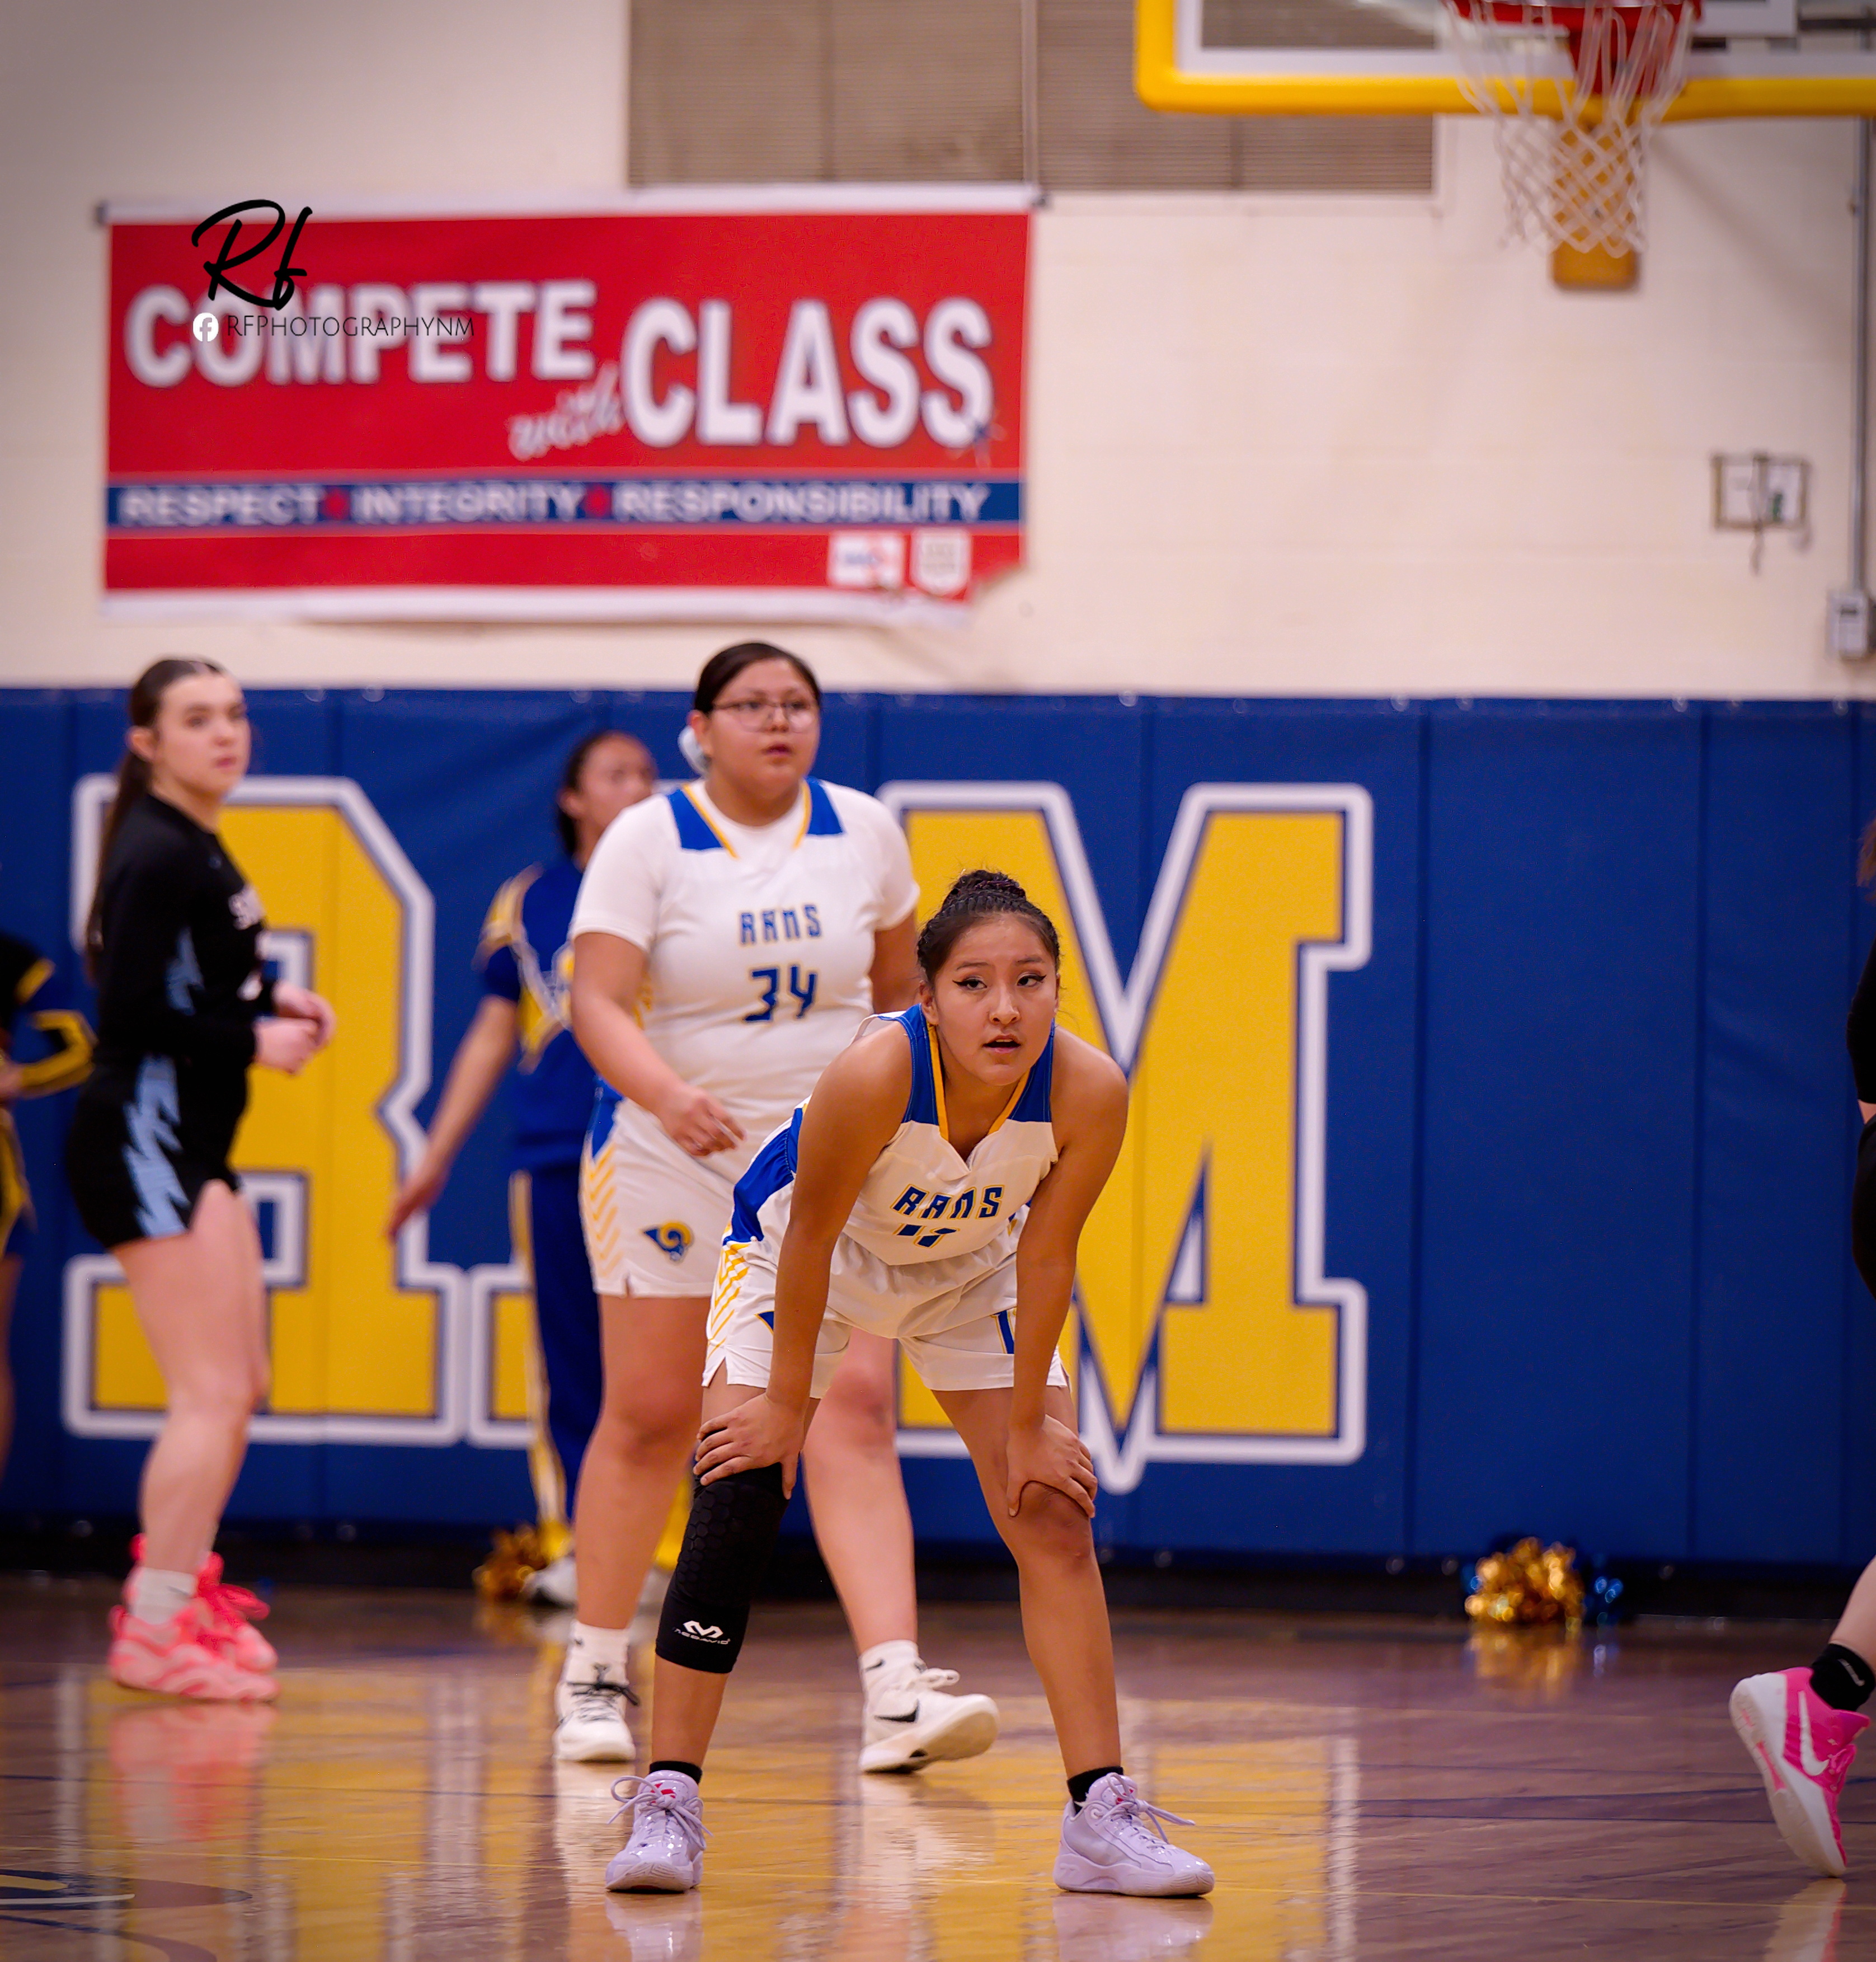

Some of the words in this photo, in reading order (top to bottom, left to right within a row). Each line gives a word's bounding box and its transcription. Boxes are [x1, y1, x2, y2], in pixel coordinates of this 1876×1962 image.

[124, 280, 596, 387] COMPETE
[620, 295, 994, 448] CLASS
[119, 485, 323, 527] RESPECT
[350, 481, 585, 524] INTEGRITY
[612, 481, 989, 524] RESPONSIBILITY
[740, 903, 821, 946] RAMS
[743, 965, 818, 1022] 34
[890, 1184, 1005, 1220] RAMS
